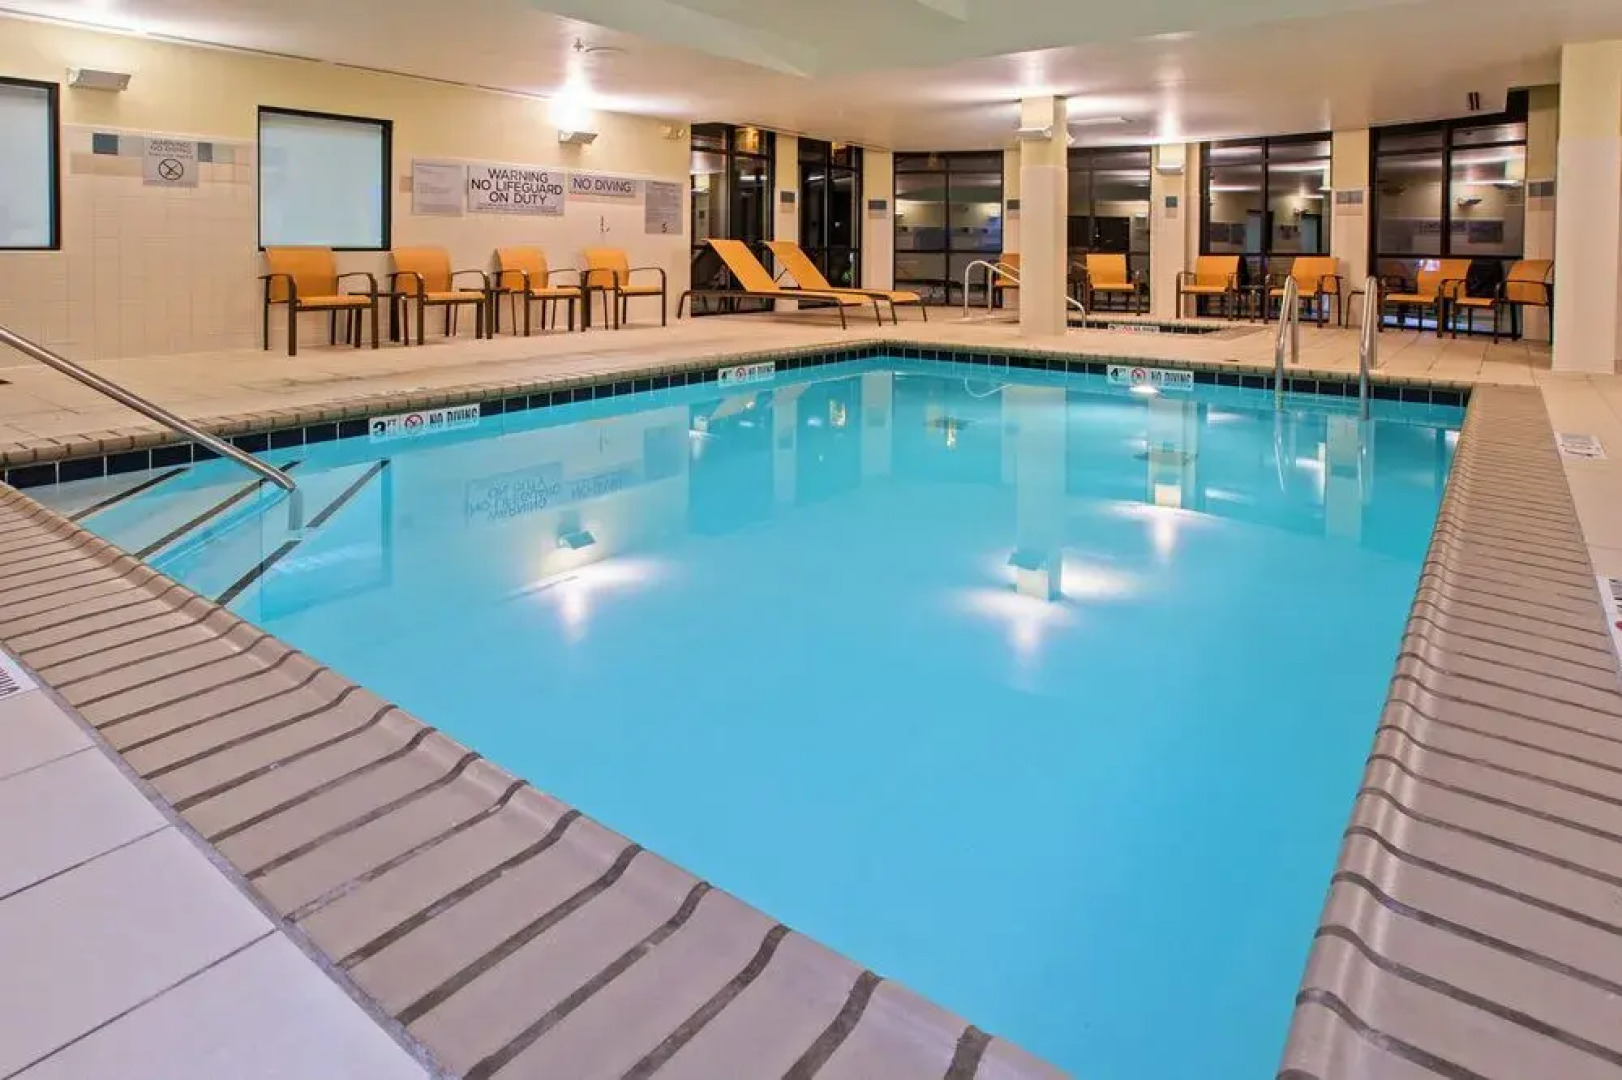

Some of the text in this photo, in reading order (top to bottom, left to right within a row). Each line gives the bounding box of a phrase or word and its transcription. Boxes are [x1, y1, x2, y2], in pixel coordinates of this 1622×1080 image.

[487, 168, 549, 184] WARNING
[471, 178, 564, 196] NO LIFEGUARD
[572, 178, 632, 193] NO DIVING
[489, 191, 548, 205] ON DUTY
